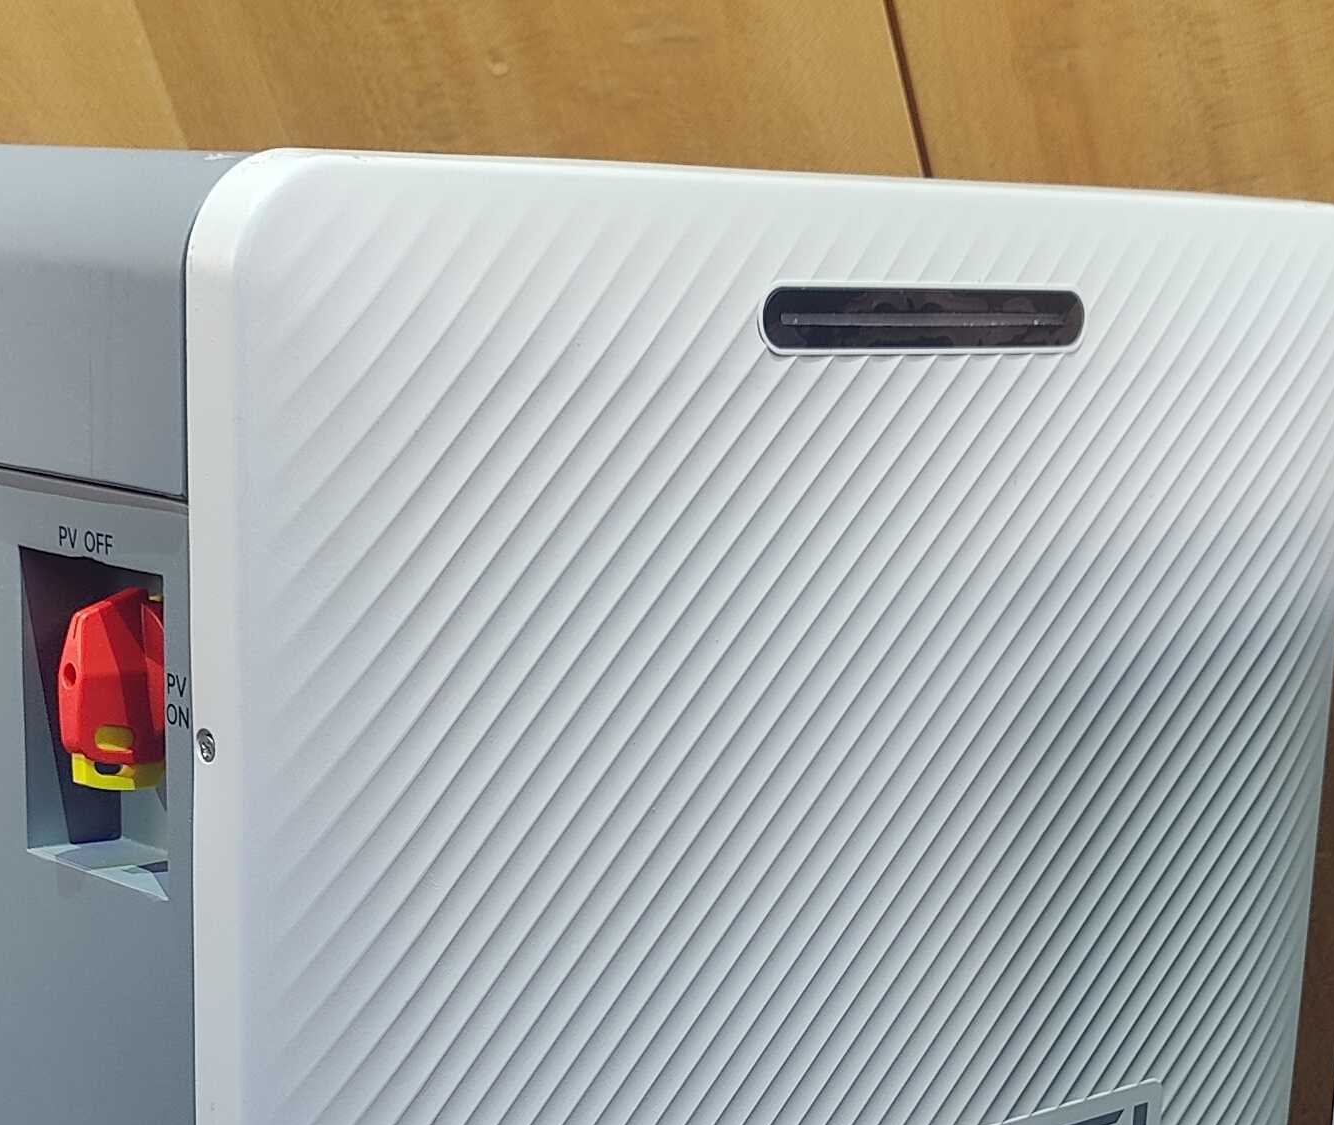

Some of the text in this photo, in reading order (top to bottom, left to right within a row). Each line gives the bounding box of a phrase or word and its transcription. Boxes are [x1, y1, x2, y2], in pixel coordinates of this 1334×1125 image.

[58, 526, 114, 555] PV OFF
[167, 673, 186, 697] PV
[167, 704, 189, 729] ON
